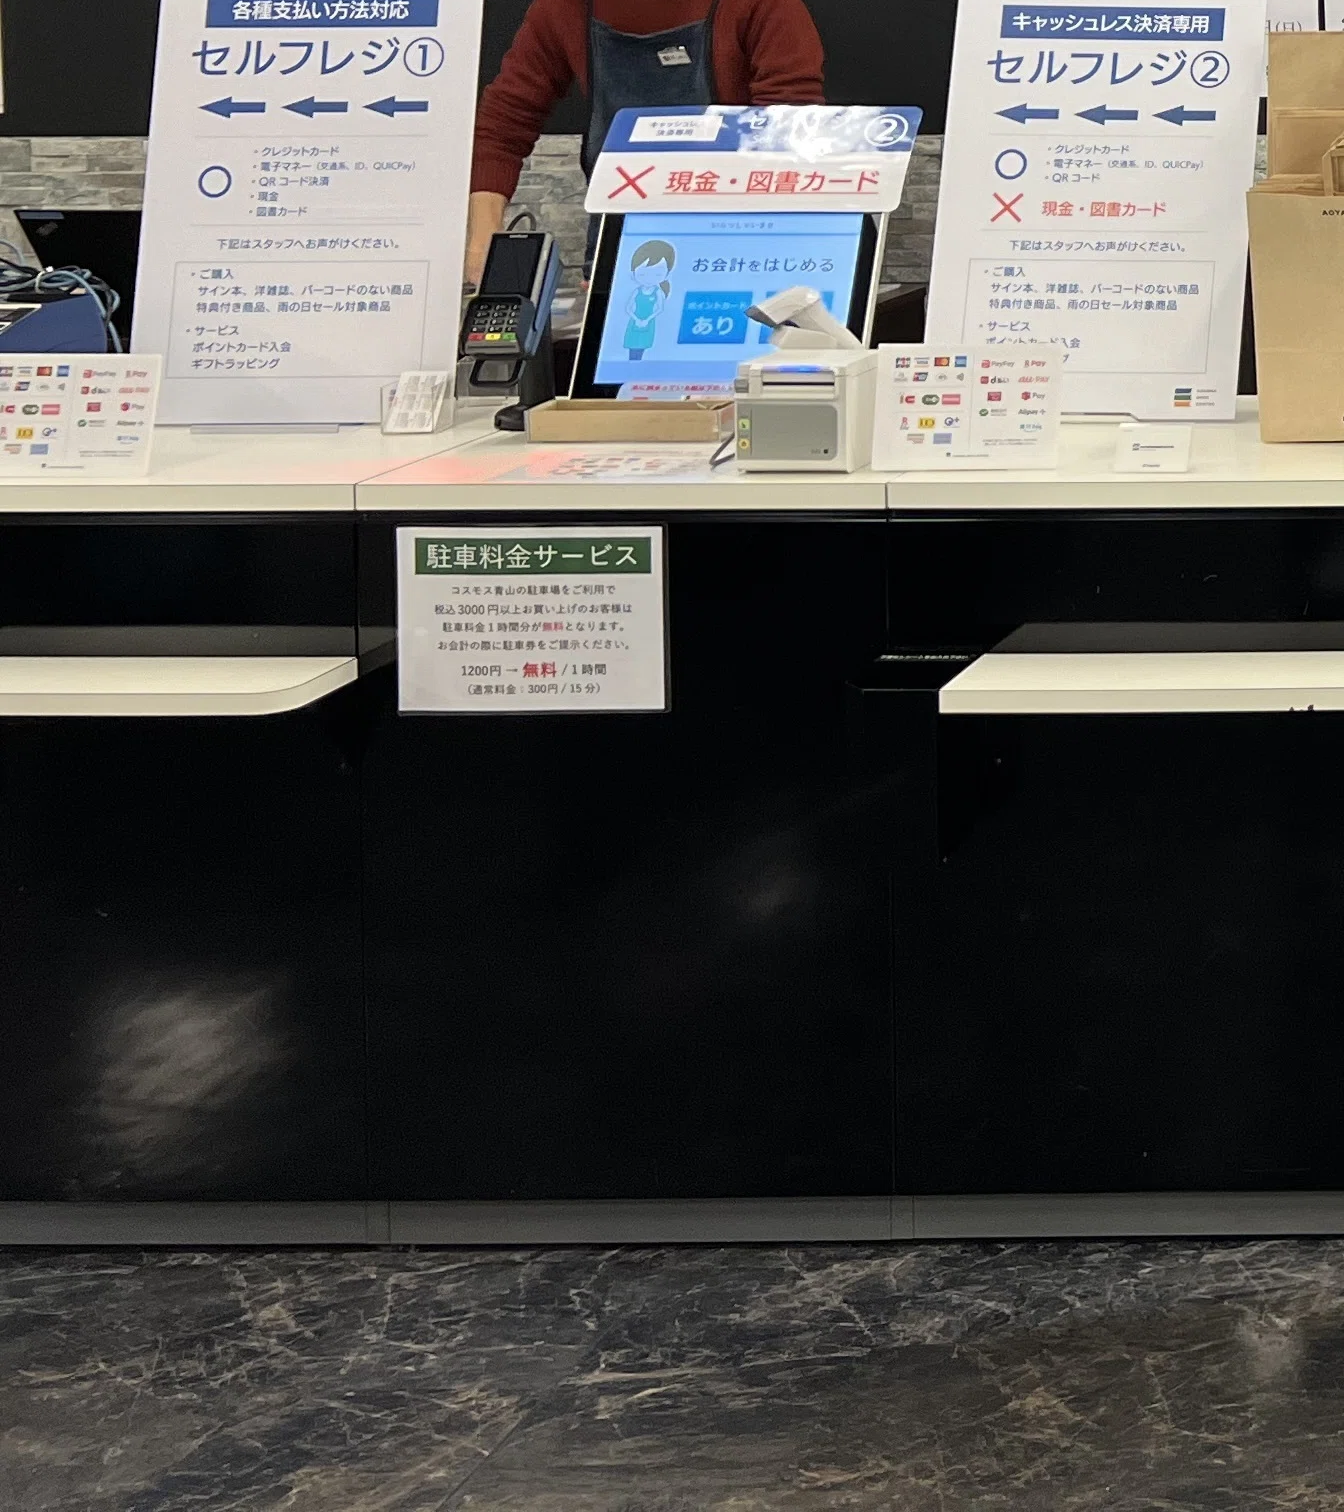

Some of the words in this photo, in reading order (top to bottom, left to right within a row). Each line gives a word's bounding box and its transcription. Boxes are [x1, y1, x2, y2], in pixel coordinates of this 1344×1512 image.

[231, 0, 410, 21] 各種支払い方法対応
[1012, 11, 1211, 35] キャッシュレス決済専用
[191, 35, 445, 78] セルフレジ①
[986, 48, 1230, 90] セルフレジ②
[261, 146, 339, 157] クレジットカード
[1054, 144, 1130, 155] クレジットカード
[260, 161, 312, 172] 電子マネー
[1053, 159, 1102, 169] 電子マネー
[258, 177, 276, 187] QR
[279, 177, 329, 187] コード決済
[665, 170, 880, 193] 現金・図書カード
[1052, 173, 1069, 183] QR
[1071, 174, 1100, 183] コード
[258, 192, 279, 202] 現金
[256, 207, 308, 217] 図書カード
[1041, 200, 1167, 217] 現金・図書カード
[217, 238, 400, 250] 下記はスタッフへお声がけください。
[1009, 240, 1186, 253] 下記はスタッフへお声がけください。
[692, 258, 835, 273] お会計をはじめる
[992, 266, 1026, 277] ご購入
[199, 269, 234, 280] ご購入
[688, 301, 747, 310] ポイントカード
[194, 326, 239, 336] サービス
[691, 316, 734, 335] あり
[987, 321, 1031, 332] サービス
[192, 342, 292, 353] ポイントカード入会
[191, 358, 280, 370] ギフトラッピング
[426, 543, 638, 570] 駐車料金サービス
[451, 584, 617, 596] コスモス青山の駐車場をご利用で
[434, 603, 633, 616] 税込3000円以上お買い上げのお客様は
[442, 621, 626, 633] 駐車料金1時間分が無料となります。
[437, 639, 631, 651] お会計の際に駐車券をご提示ください。
[461, 664, 502, 677] 1200円
[522, 662, 557, 679] 無料
